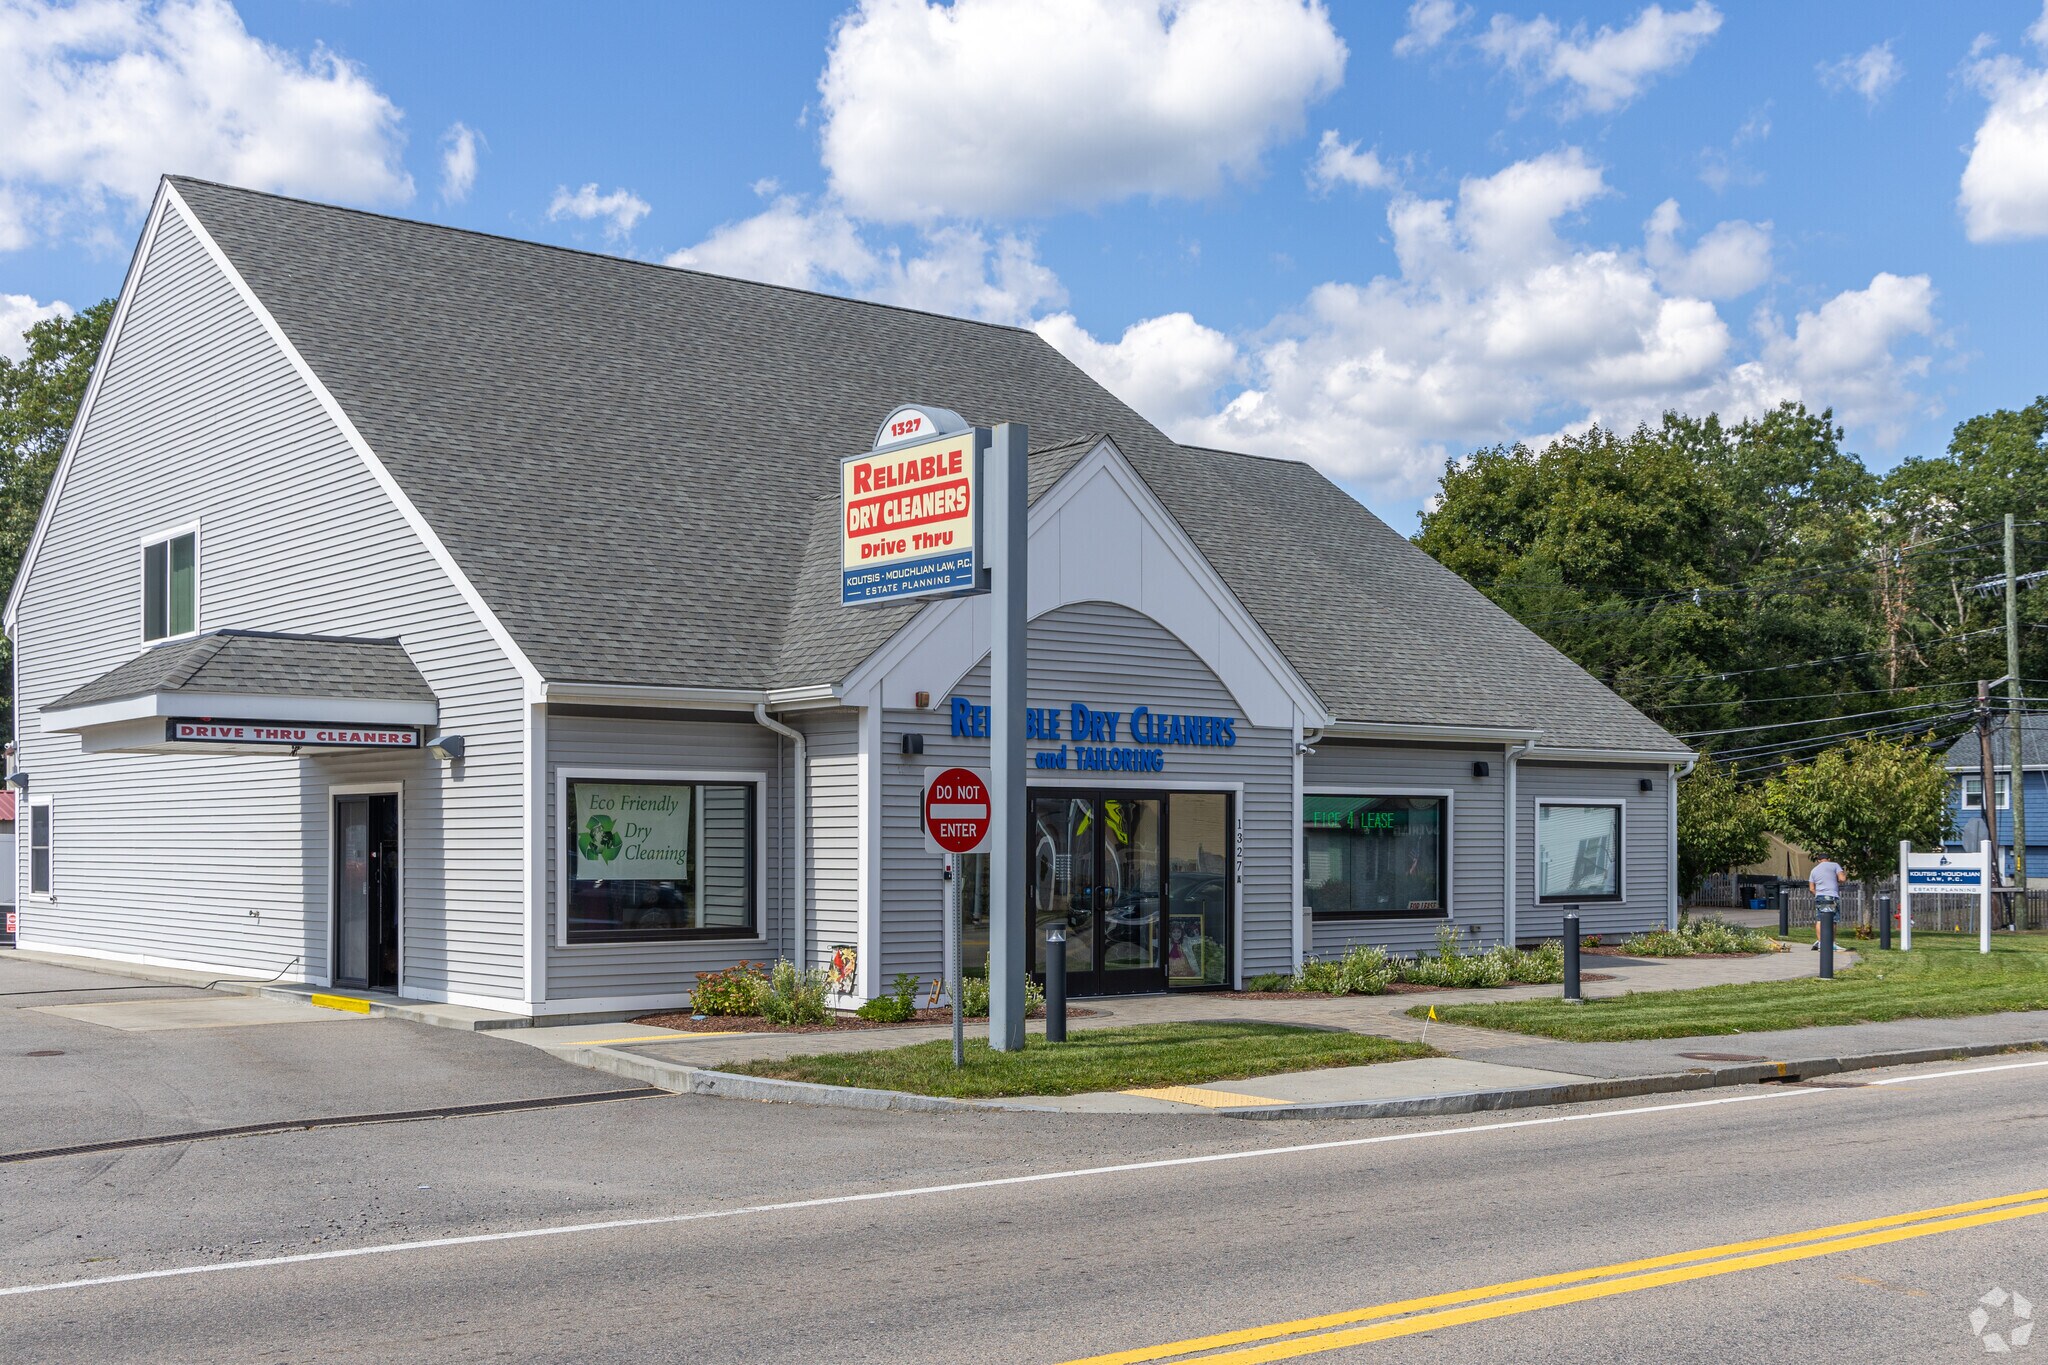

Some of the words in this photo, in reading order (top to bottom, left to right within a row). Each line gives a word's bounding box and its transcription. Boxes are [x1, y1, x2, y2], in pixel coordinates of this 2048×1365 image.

[891, 418, 921, 437] 1327
[853, 450, 963, 495] RELIABLE
[849, 503, 881, 532] DRY
[883, 485, 967, 525] CLEANERS
[861, 538, 907, 559] Drive
[912, 530, 954, 550] Thru
[847, 573, 880, 587] KOUTSIS
[886, 564, 935, 580] MOUCHLIAN
[936, 561, 955, 572] LAW,
[957, 558, 972, 569] P.C.
[865, 583, 898, 596] ESTATE
[902, 575, 951, 590] PLANNING
[951, 697, 1061, 741] RELBLE
[1070, 702, 1121, 743] DRY
[1130, 706, 1236, 747] CLEANERS
[180, 726, 244, 738] DRIVE
[253, 728, 306, 740] THRU
[316, 731, 412, 744] CLEANERS
[1035, 744, 1068, 770] and
[1074, 746, 1165, 772] TAILORING
[936, 785, 953, 800] DO
[957, 785, 980, 800] NOT
[589, 794, 615, 811] Eco
[620, 794, 679, 816] Friendly
[940, 823, 977, 837] ENTER
[1347, 810, 1354, 829] 4
[1361, 812, 1395, 829] LEASE
[624, 822, 652, 843] Dry
[624, 844, 687, 865] Cleaning
